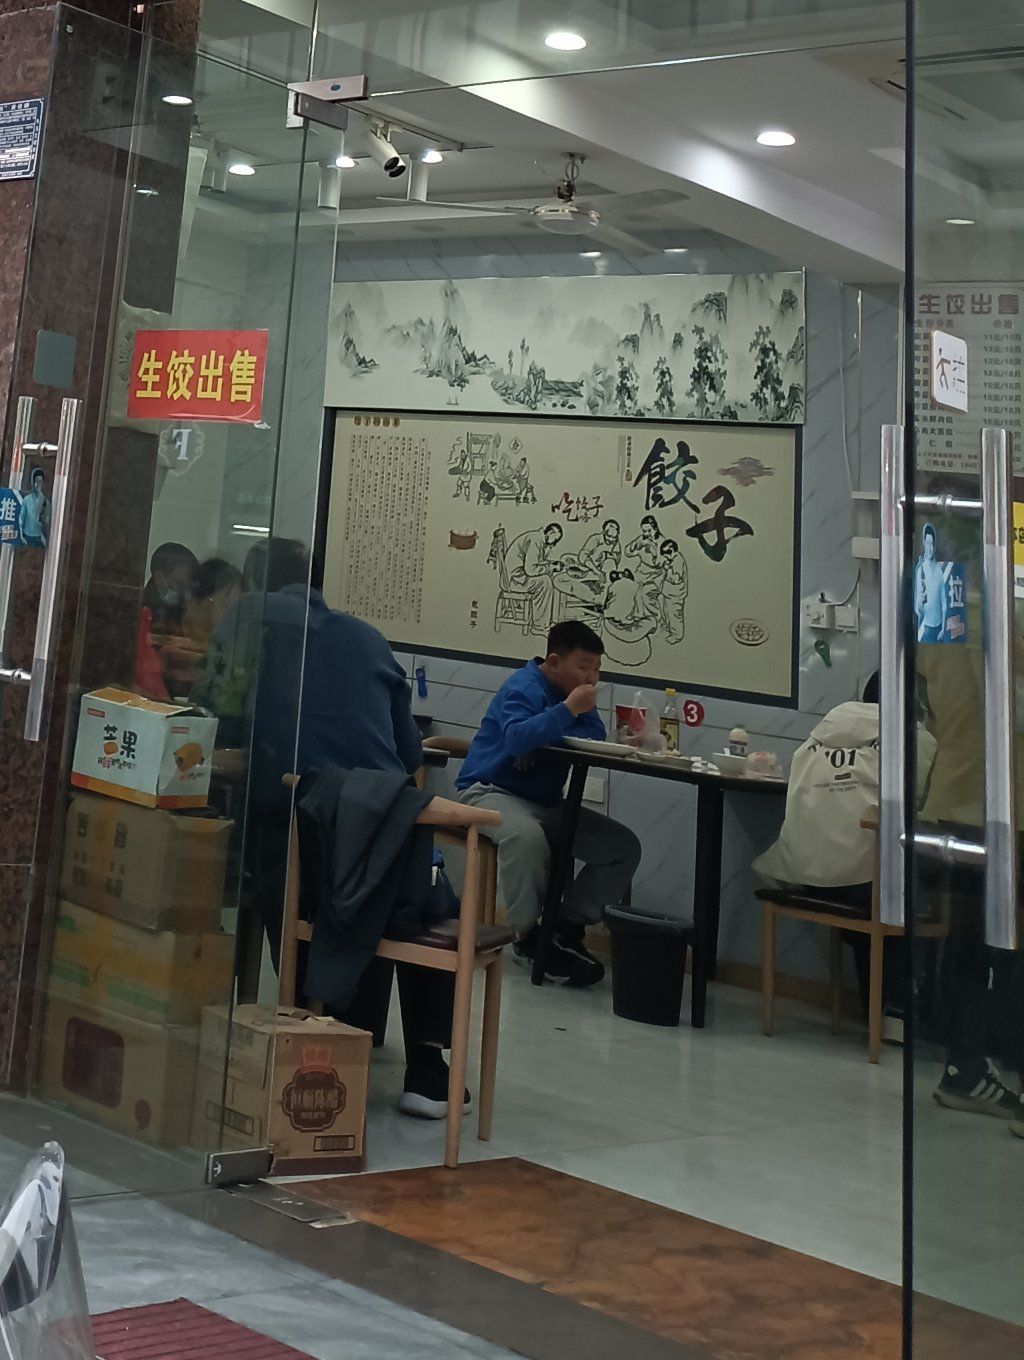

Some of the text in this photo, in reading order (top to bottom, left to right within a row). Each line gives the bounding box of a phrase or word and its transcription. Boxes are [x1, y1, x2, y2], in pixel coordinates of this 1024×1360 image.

[918, 294, 1020, 316] 生饺出售
[135, 349, 258, 403] 生饺出售
[0, 497, 17, 521] 推
[948, 574, 965, 609] 拉
[686, 703, 699, 723] 3
